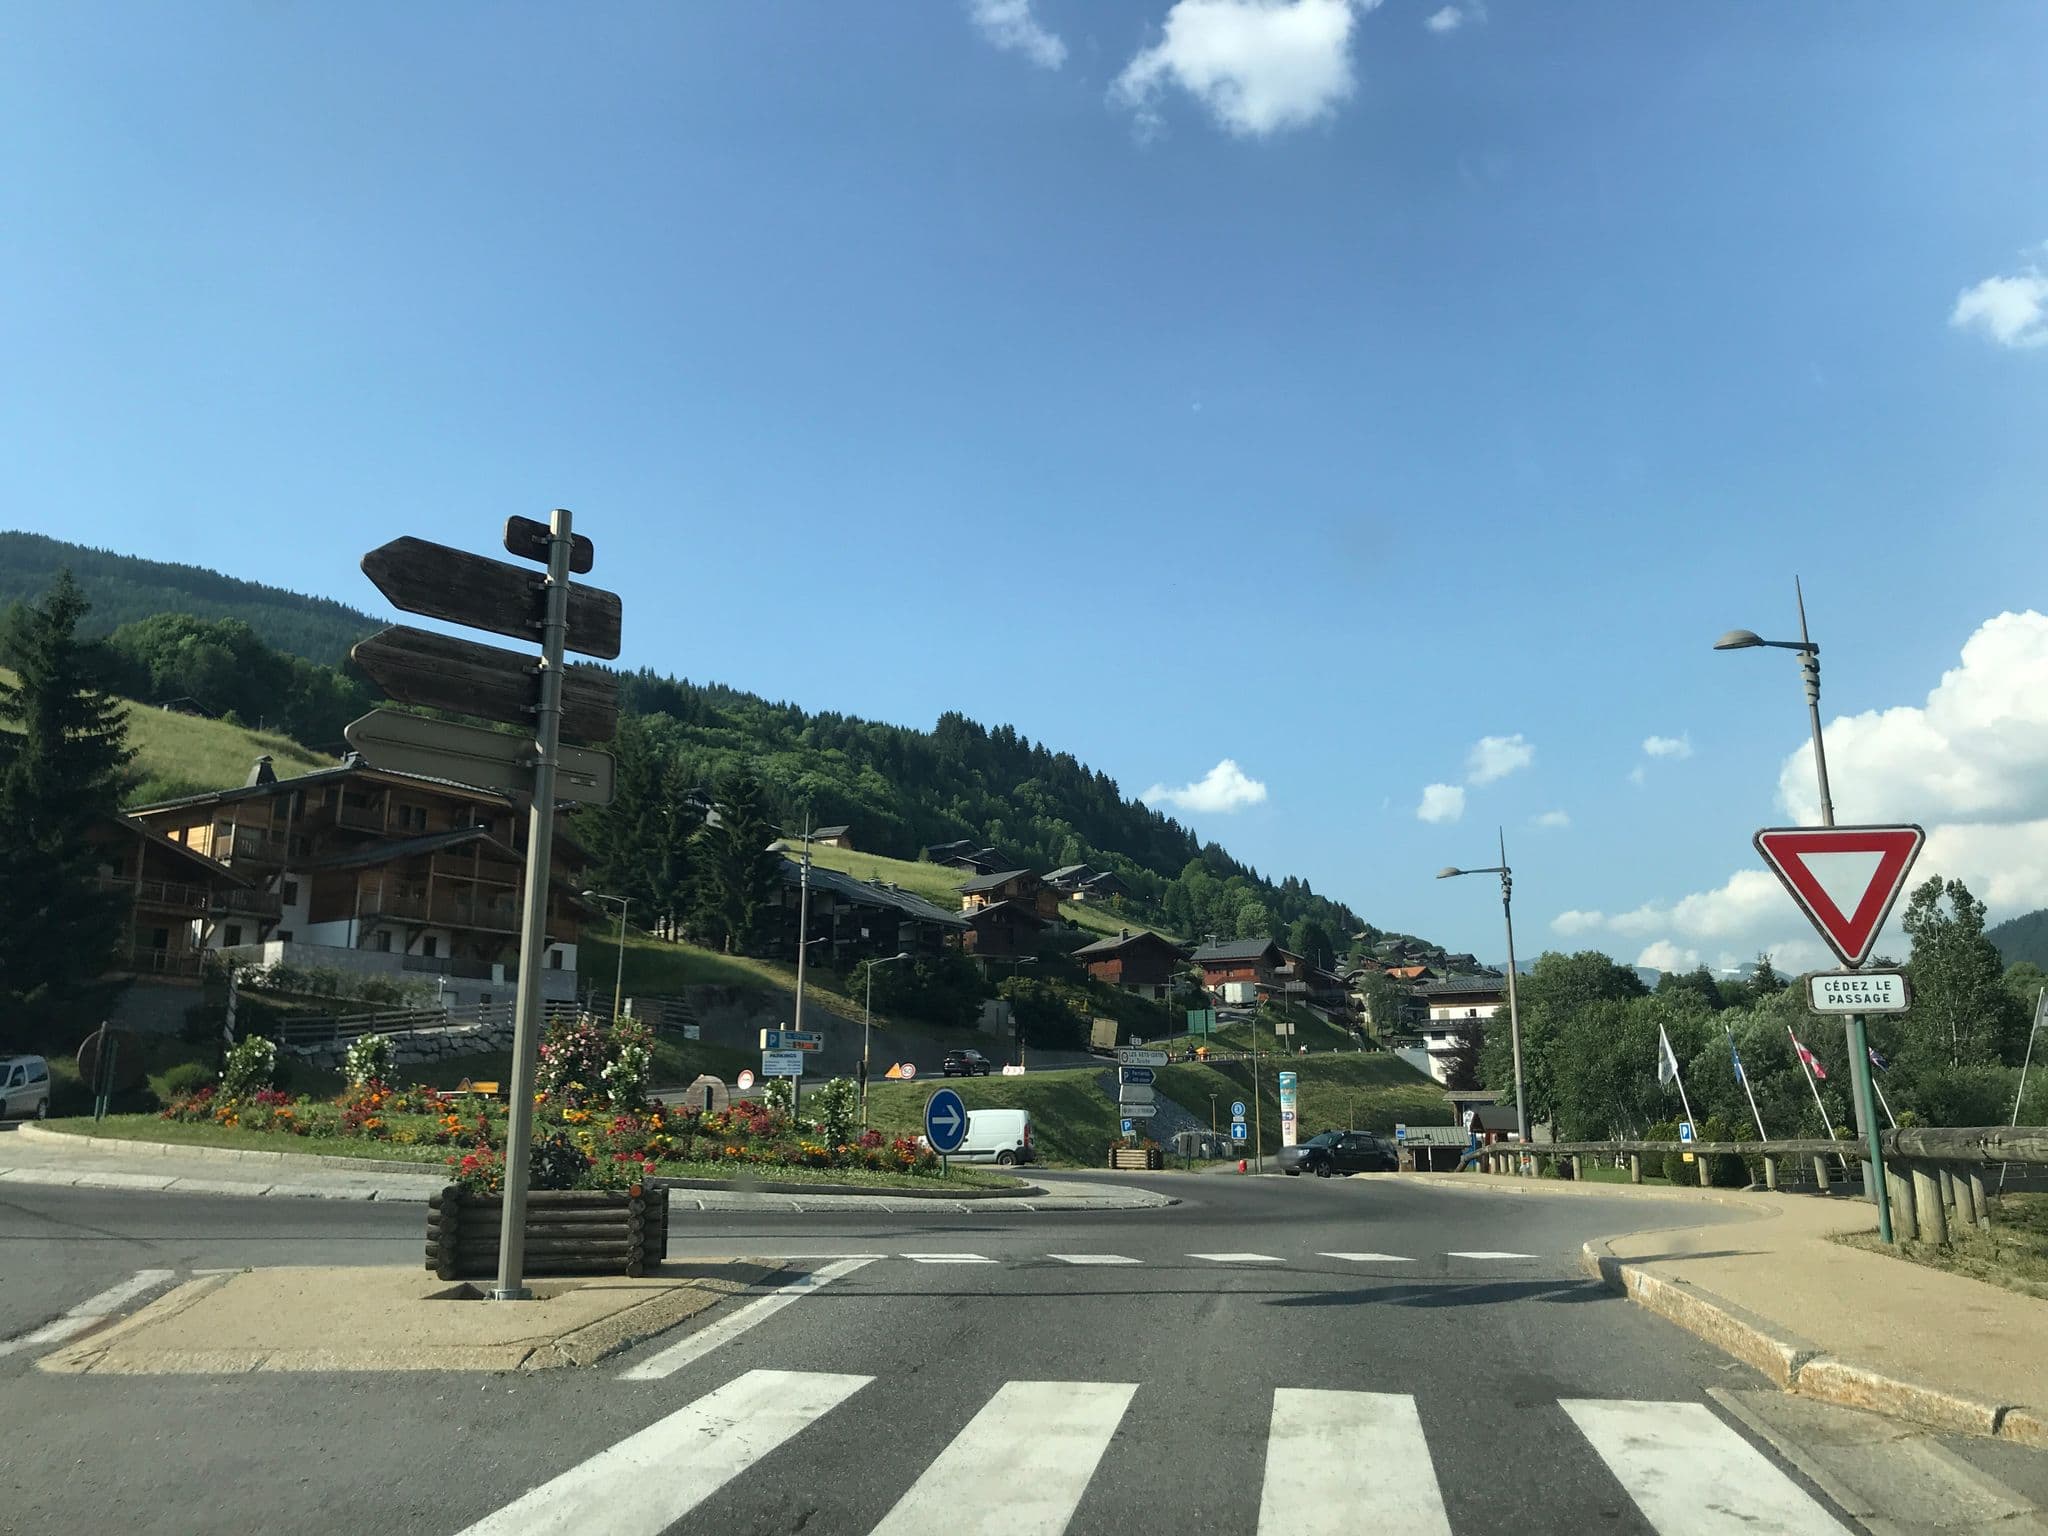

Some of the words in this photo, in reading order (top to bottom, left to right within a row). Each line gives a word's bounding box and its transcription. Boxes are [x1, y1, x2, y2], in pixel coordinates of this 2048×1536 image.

[1824, 980, 1868, 991] CÉDEZ
[1876, 981, 1891, 990] LE
[1828, 994, 1890, 1003] PASSAGE
[1124, 1121, 1131, 1130] P
[1682, 1126, 1687, 1138] P
